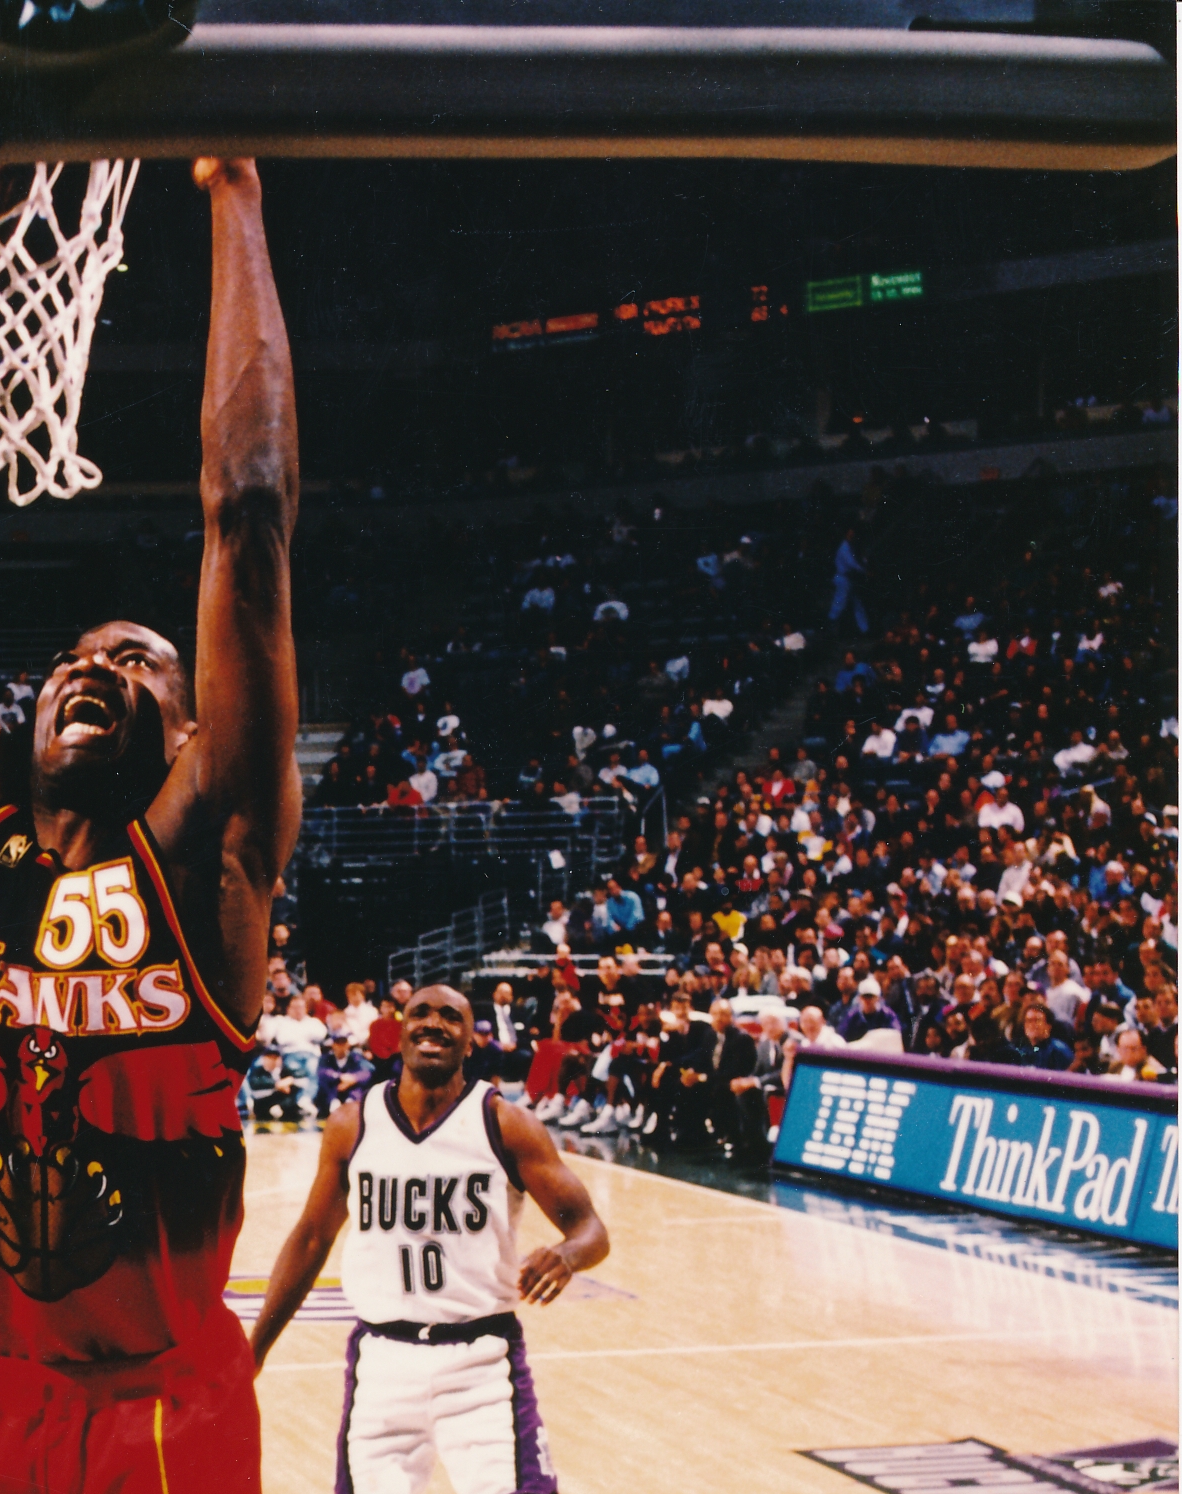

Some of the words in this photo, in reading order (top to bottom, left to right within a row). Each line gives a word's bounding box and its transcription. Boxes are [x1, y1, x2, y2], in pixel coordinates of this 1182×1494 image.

[35, 856, 150, 970] 55
[801, 1070, 917, 1180] IBM
[939, 1093, 1149, 1227] ThinkPad
[358, 1169, 495, 1235] BUCKS
[398, 1240, 447, 1295] 10
